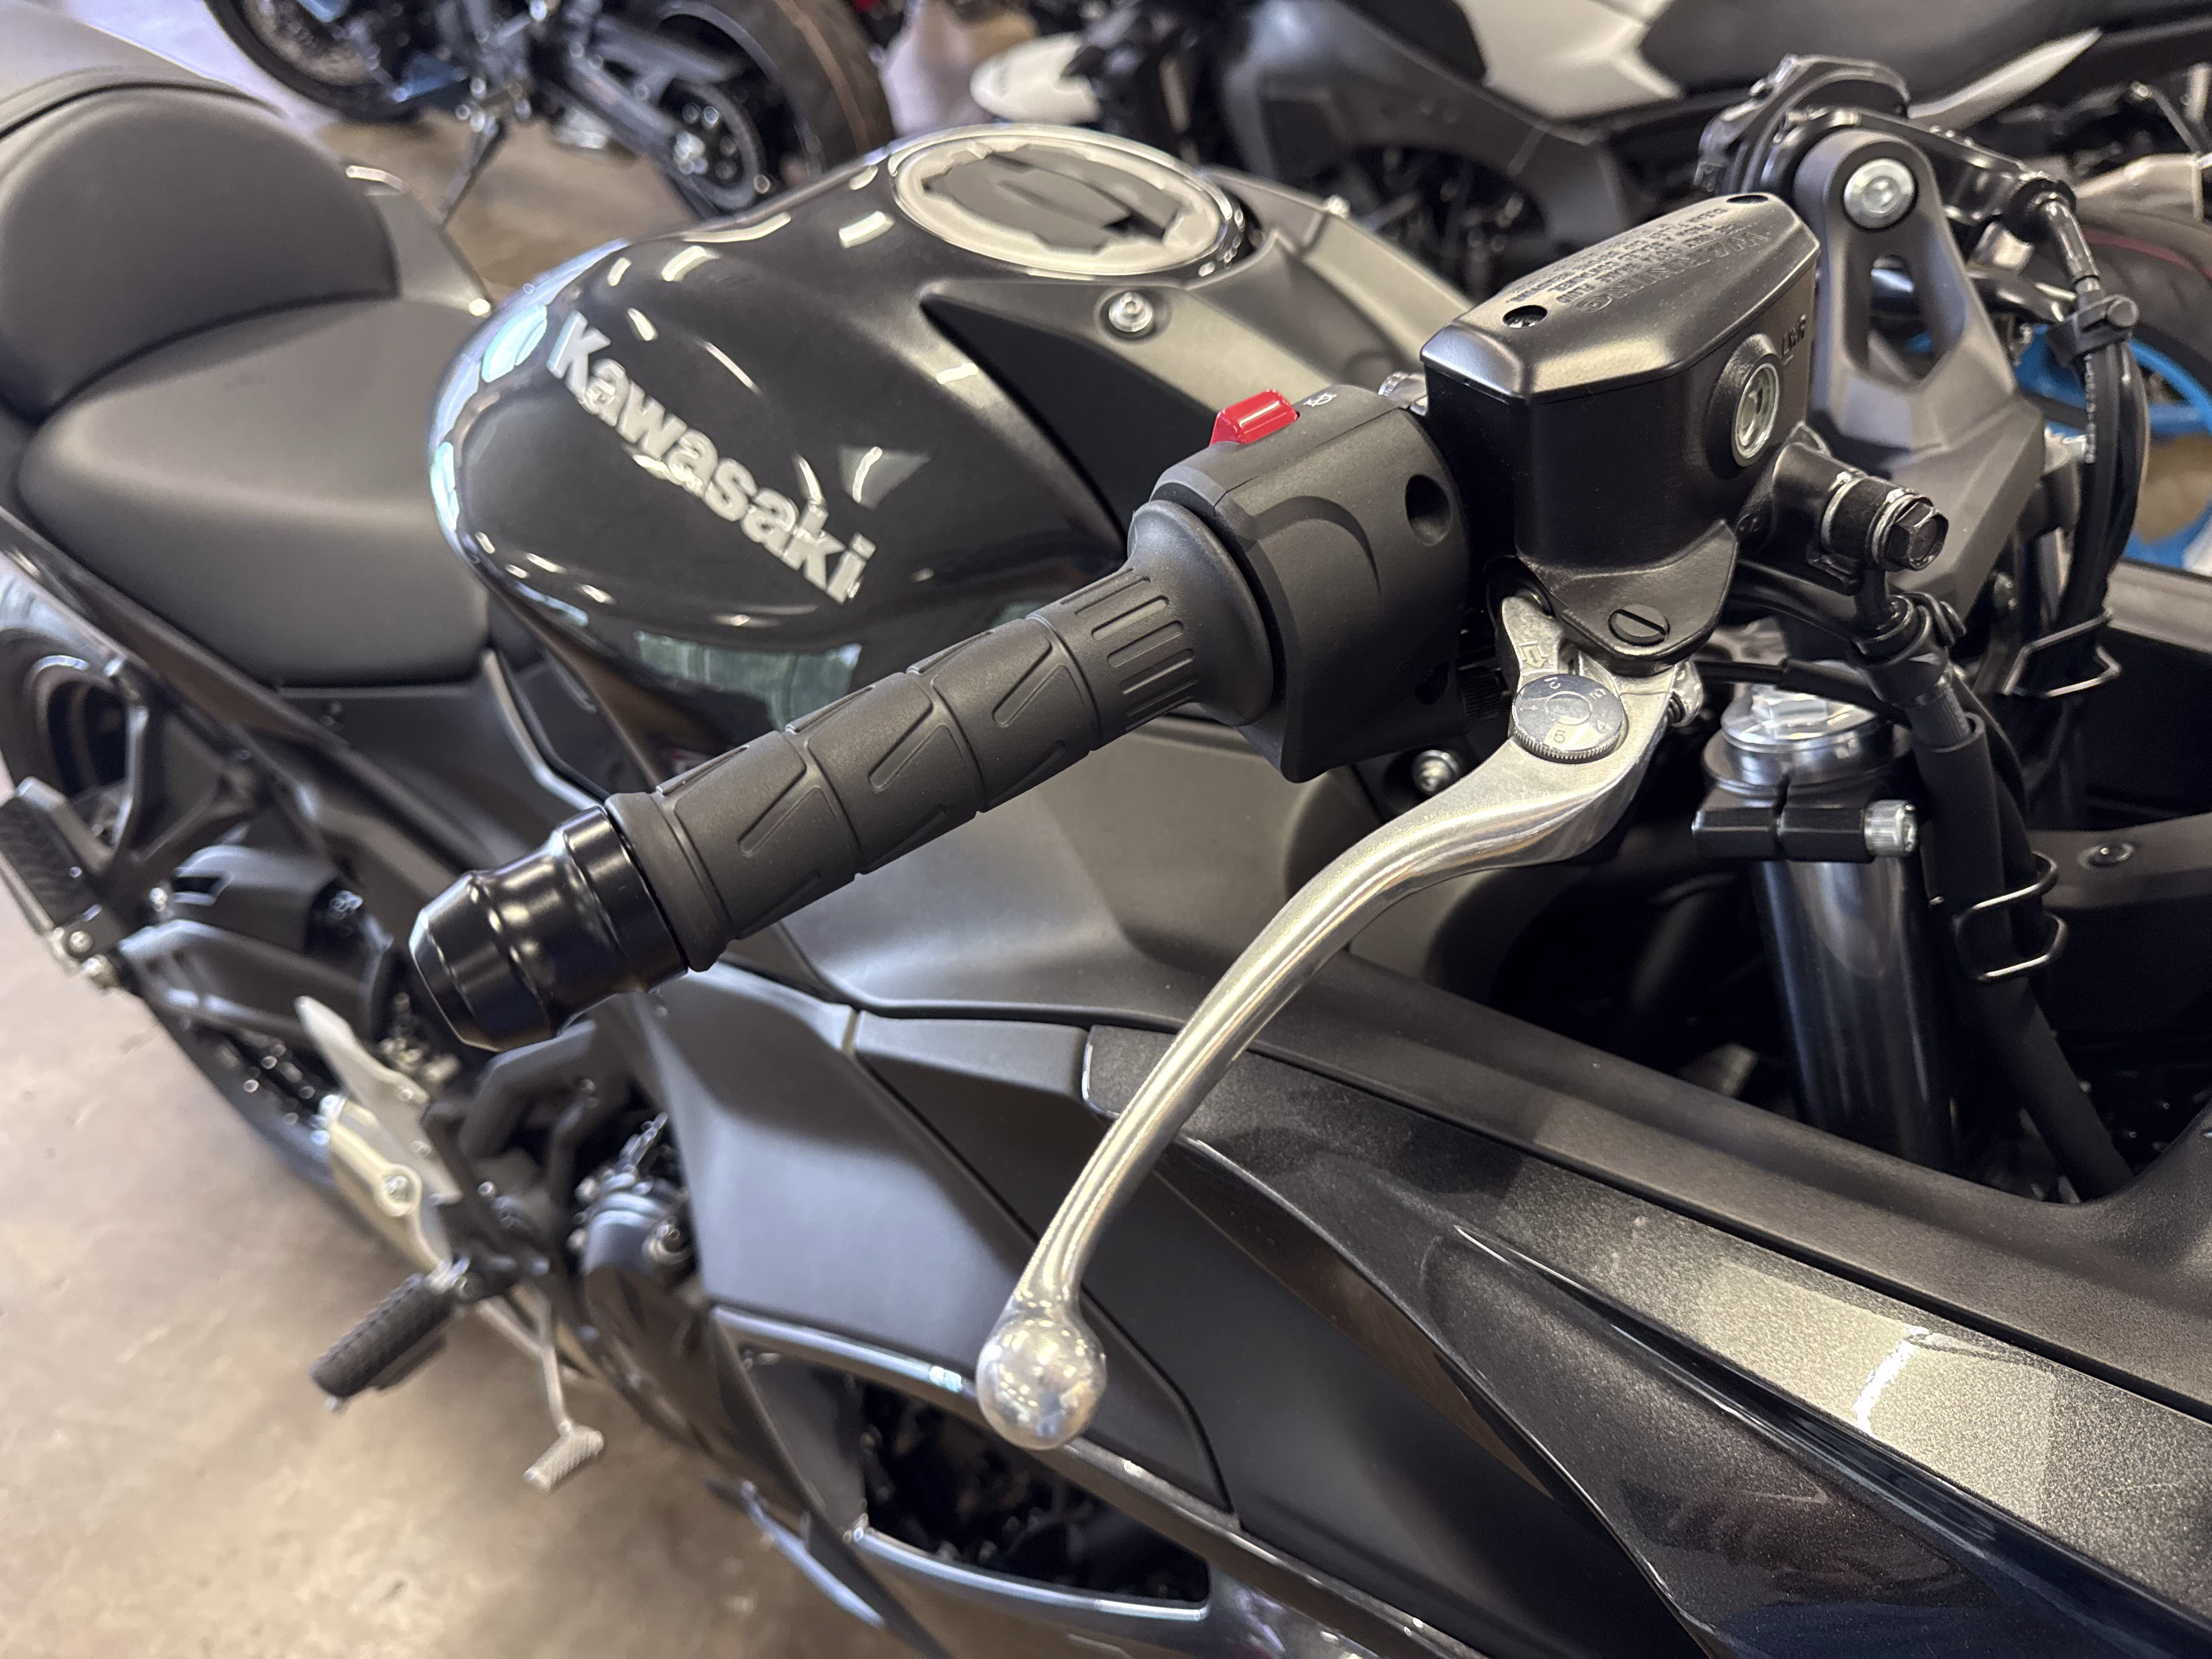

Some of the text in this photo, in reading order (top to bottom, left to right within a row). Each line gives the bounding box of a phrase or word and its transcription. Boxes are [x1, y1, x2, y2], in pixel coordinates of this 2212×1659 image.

[1554, 283, 1598, 304] FLUID
[547, 311, 876, 604] Kawasaki
[1544, 676, 1561, 689] 2
[1595, 719, 1613, 734] 4
[1553, 729, 1566, 743] 5
